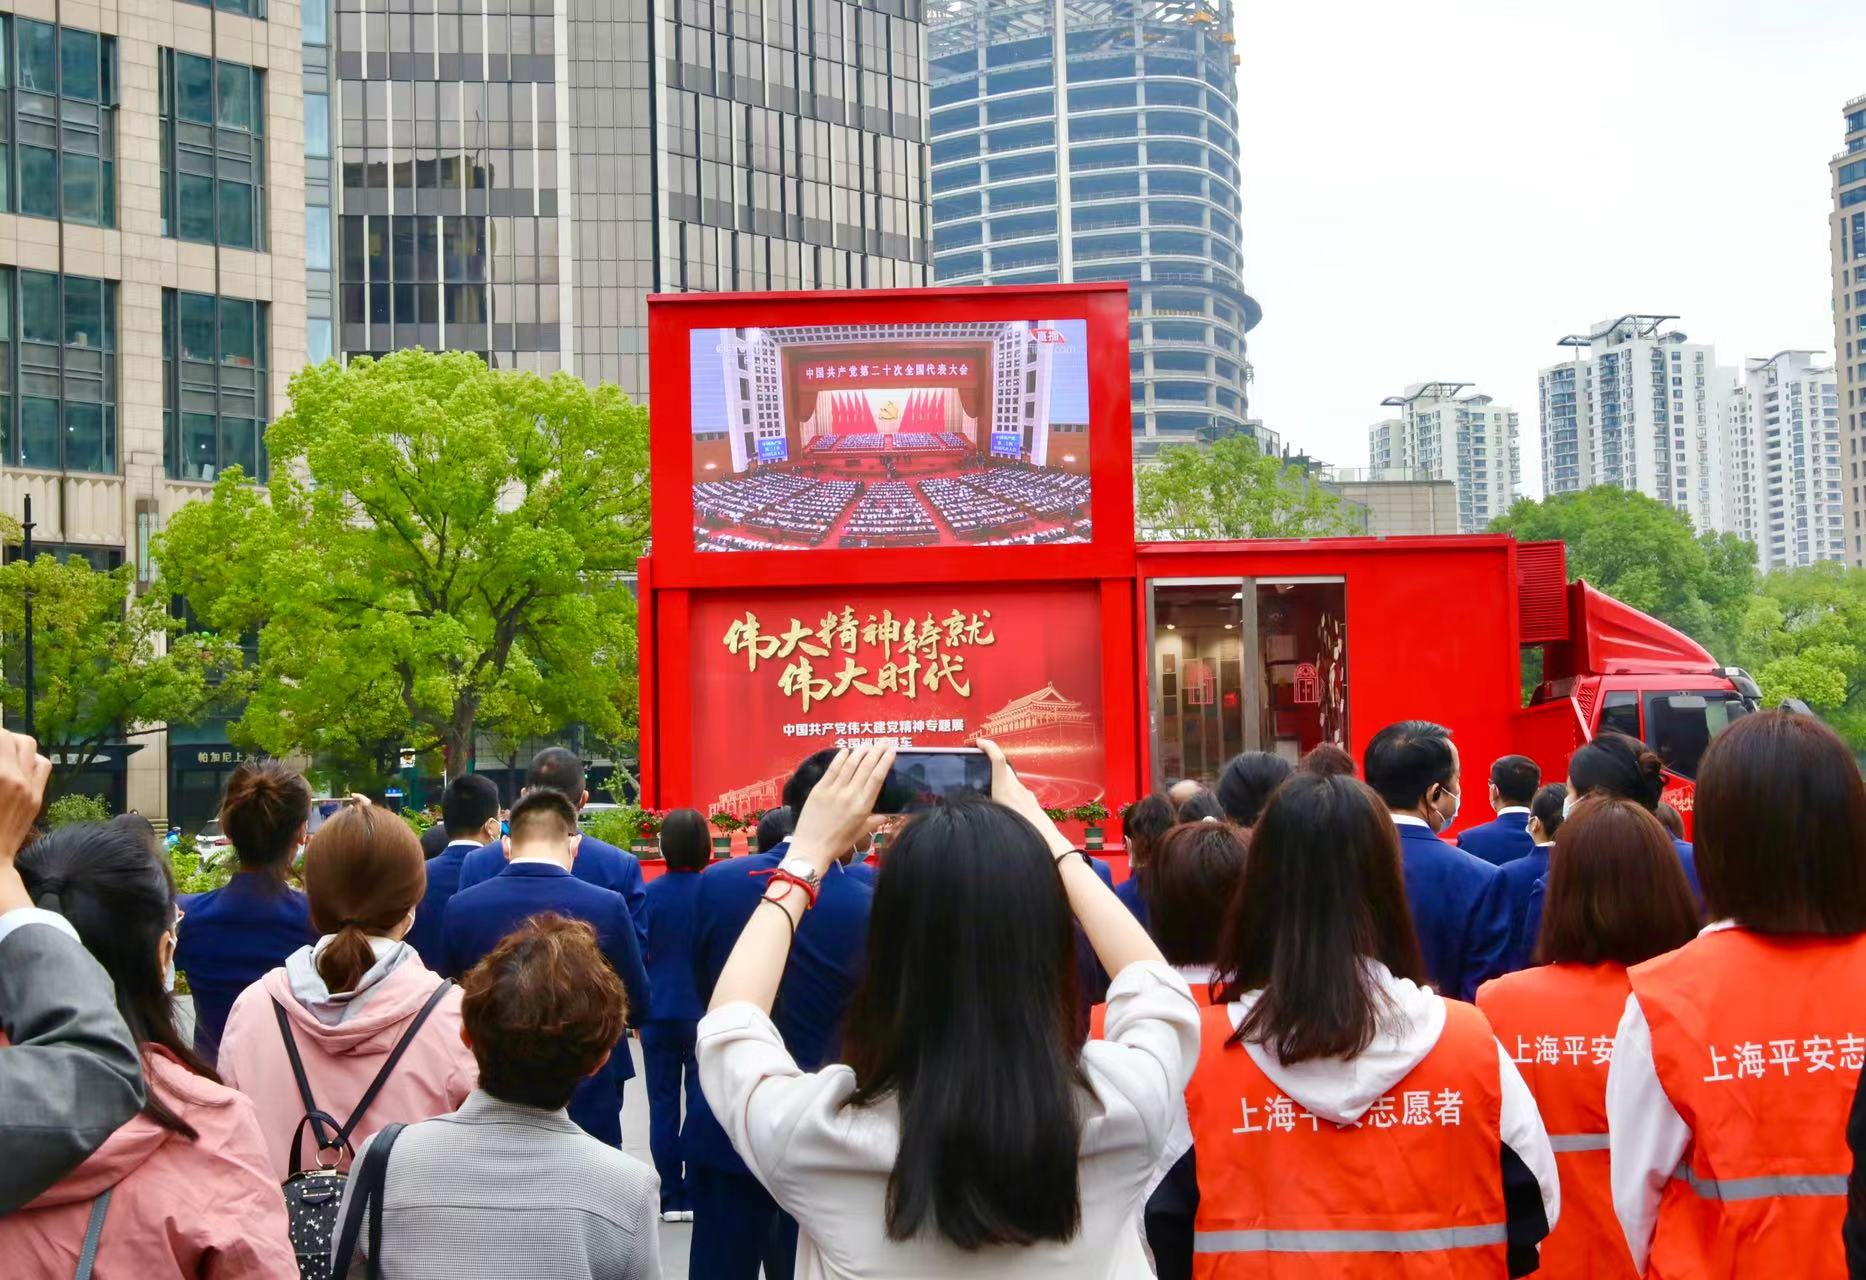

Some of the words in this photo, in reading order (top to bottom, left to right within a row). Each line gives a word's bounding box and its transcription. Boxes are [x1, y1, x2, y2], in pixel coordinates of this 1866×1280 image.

[805, 363, 969, 380] 中国共产党第二十次全国代表大会
[723, 605, 995, 672] 伟大精神铸就
[778, 656, 971, 713] 伟大时代
[783, 719, 964, 737] 中国共产党伟大建党精神专题展
[1512, 1034, 1616, 1066] 上海平安
[1703, 1032, 1866, 1082] 上海平安志
[1232, 1087, 1464, 1135] 上海志愿者
